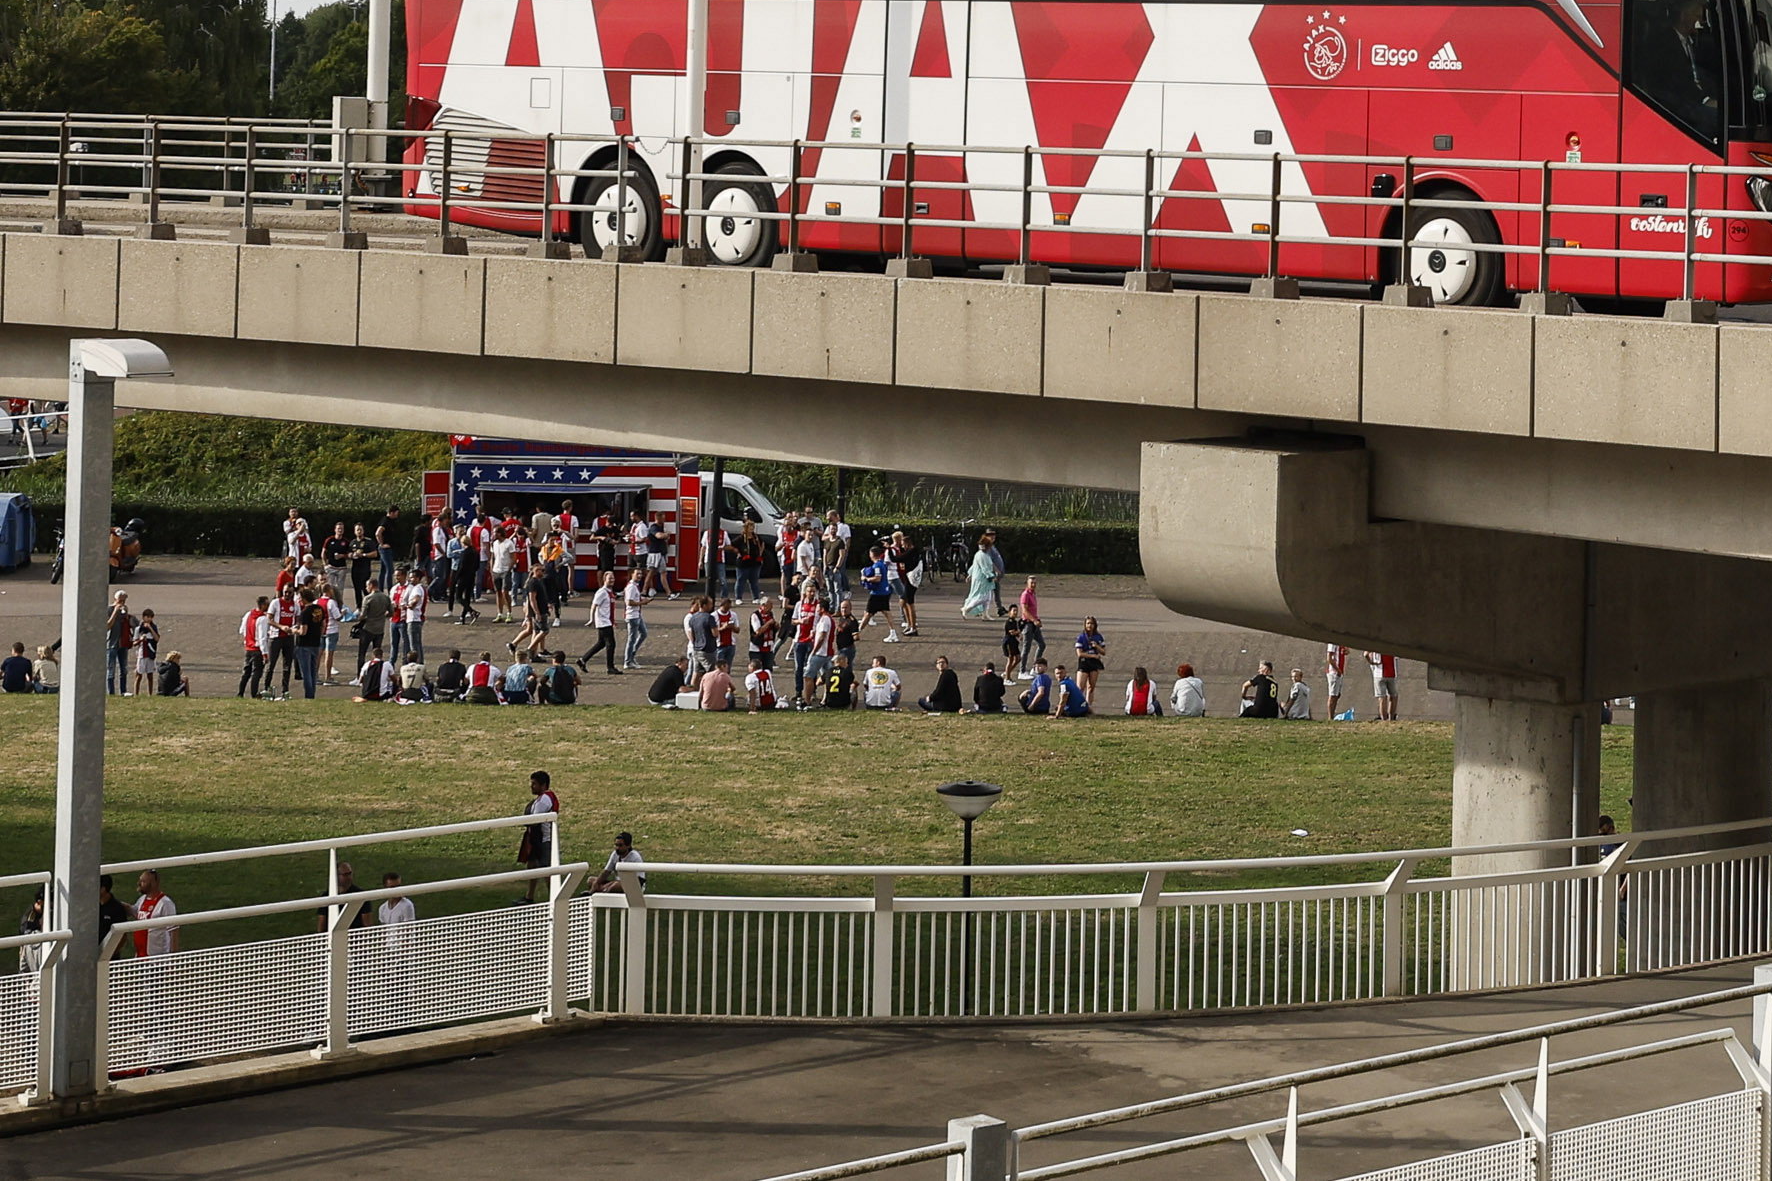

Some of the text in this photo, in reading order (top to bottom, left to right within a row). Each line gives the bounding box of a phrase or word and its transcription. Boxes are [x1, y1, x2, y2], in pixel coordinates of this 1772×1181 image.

[1428, 59, 1463, 70] adidas
[407, 675, 416, 688] 7
[760, 679, 772, 696] 14
[829, 675, 840, 693] 2
[1270, 683, 1276, 698] 8
